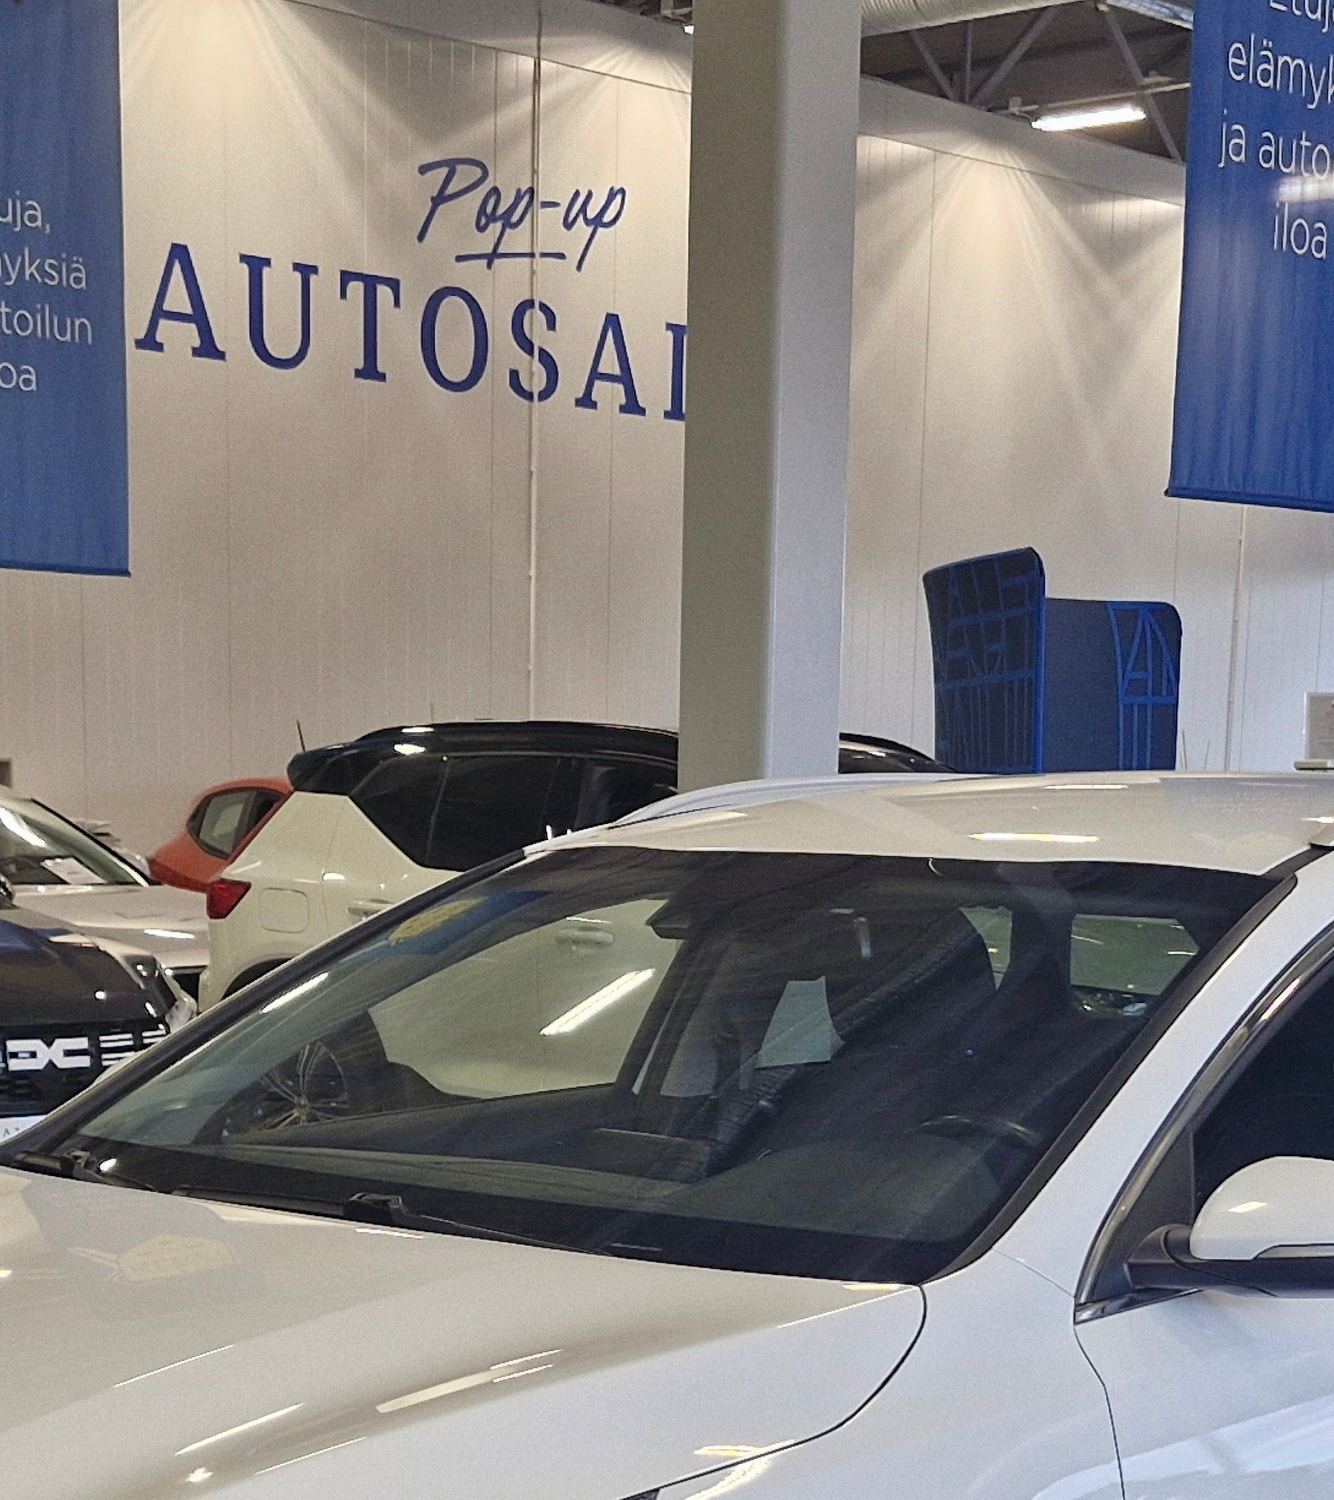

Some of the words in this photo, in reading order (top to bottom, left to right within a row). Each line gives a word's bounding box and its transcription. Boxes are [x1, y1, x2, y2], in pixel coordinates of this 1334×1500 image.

[1218, 109, 1246, 169] ja
[417, 157, 627, 272] Pop-up
[1273, 202, 1327, 260] iloa
